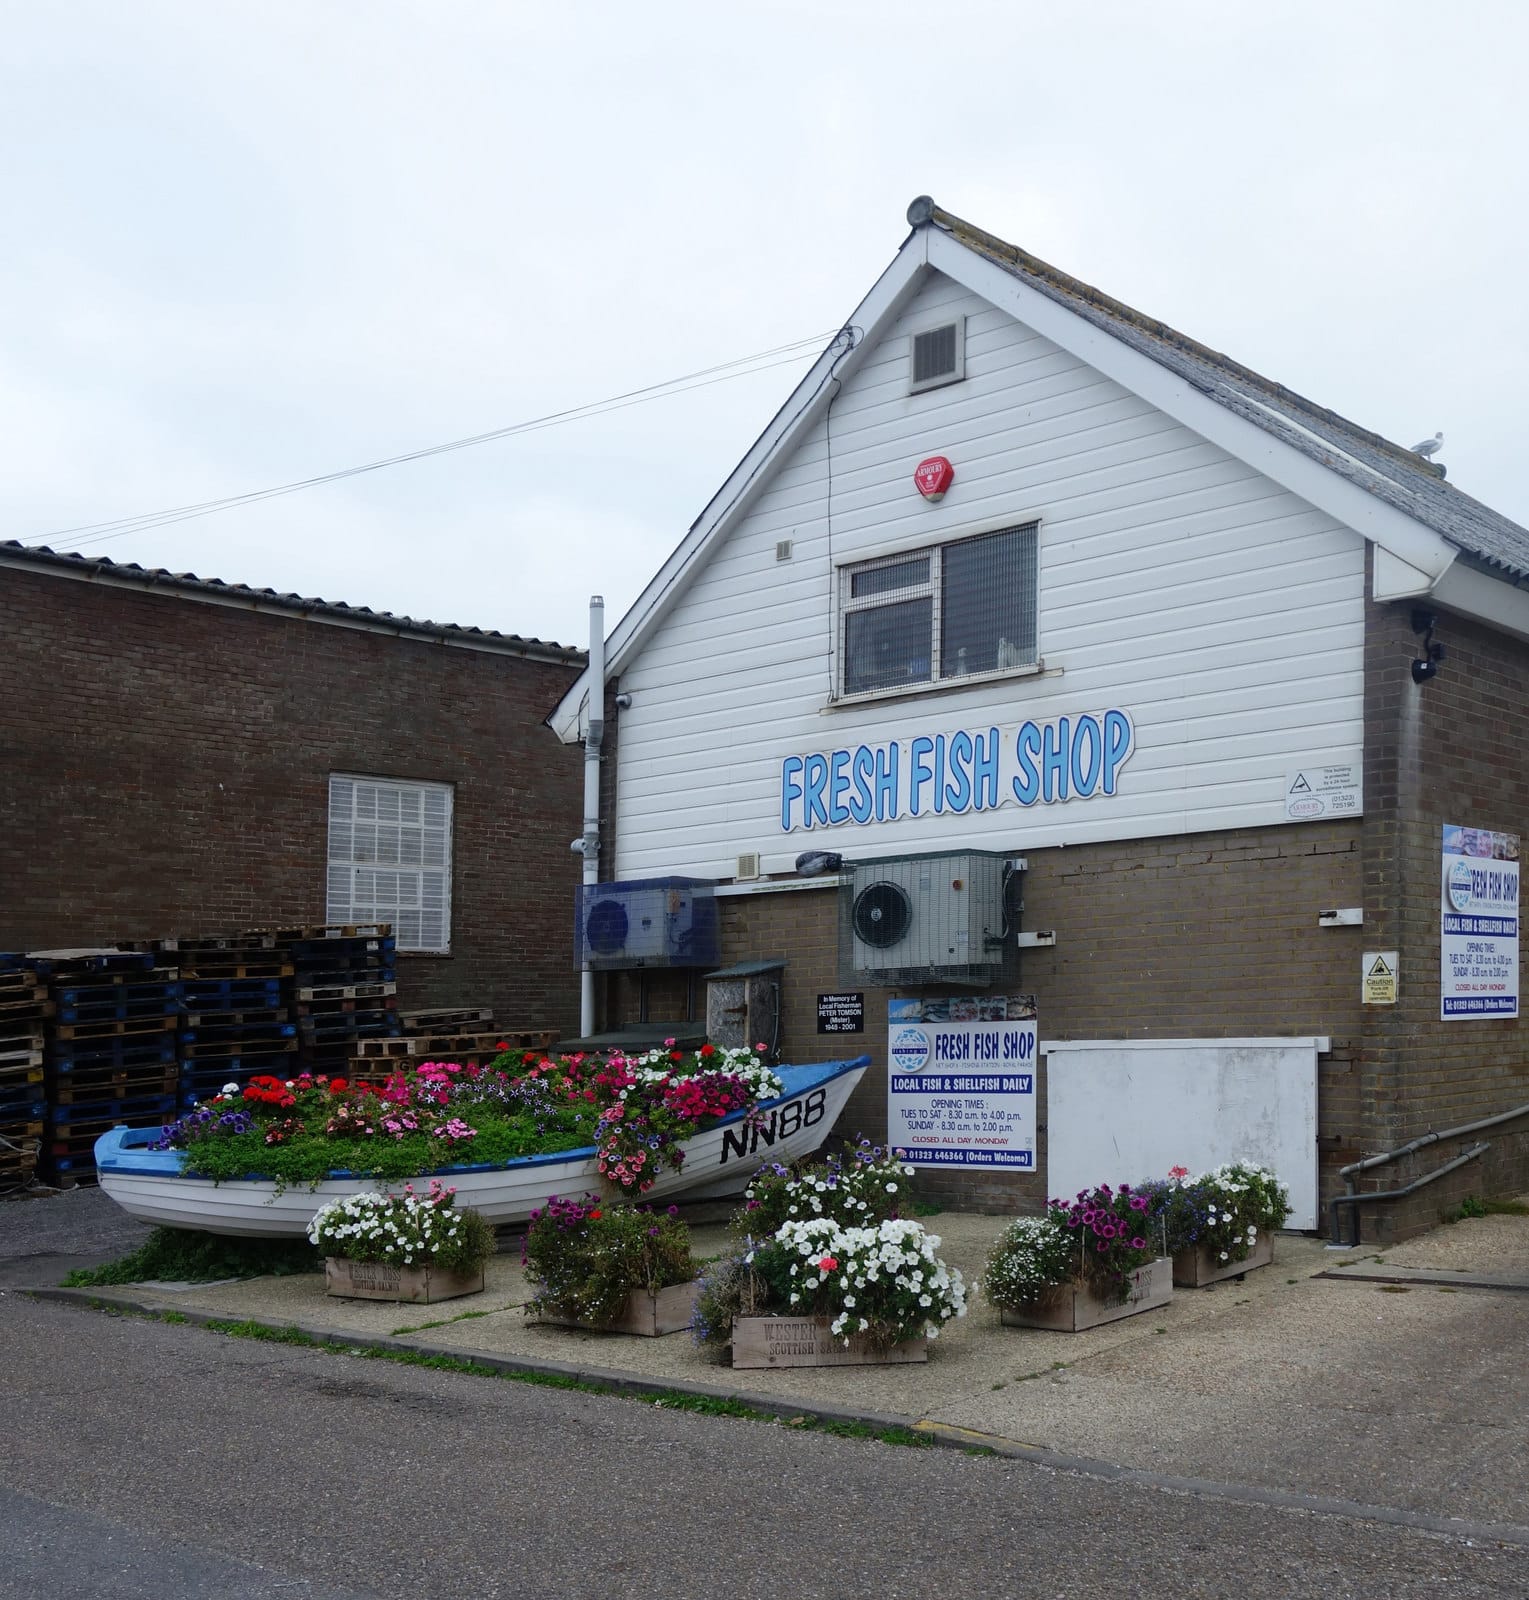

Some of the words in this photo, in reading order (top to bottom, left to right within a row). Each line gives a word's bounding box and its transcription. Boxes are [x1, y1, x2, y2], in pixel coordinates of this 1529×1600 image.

[781, 741, 899, 832] FRESH
[909, 726, 1000, 817] FISH
[1012, 709, 1131, 806] SHOP
[1470, 869, 1487, 899] RESH
[1489, 872, 1502, 900] FISH
[1503, 872, 1517, 902] SHOP
[1445, 917, 1460, 931] LOCAL
[935, 1032, 970, 1060] FRESH
[974, 1031, 999, 1060] FISH
[1003, 1031, 1034, 1060] SHOP
[894, 1077, 920, 1091] LOCAL
[922, 1078, 942, 1091] FISH
[944, 1078, 951, 1090] &
[954, 1078, 1000, 1091] SHELLFISH
[1003, 1077, 1029, 1091] DAILY
[931, 1099, 962, 1109] OPENING
[964, 1099, 984, 1109] TIMES
[901, 1109, 916, 1119] TUES
[919, 1109, 928, 1119] TO
[930, 1110, 942, 1119] SAT
[948, 1110, 962, 1120] 8.30
[965, 1112, 978, 1120] a.m.
[981, 1111, 988, 1120] to
[990, 1110, 1005, 1120] 4.00
[1007, 1113, 1021, 1122] p.m.
[720, 1088, 826, 1164] NN88
[908, 1121, 935, 1130] SUNDAY
[941, 1122, 956, 1130] 8.30
[958, 1123, 971, 1131] a.m.
[974, 1122, 980, 1131] to
[982, 1122, 997, 1131] 2.00
[999, 1124, 1013, 1134] p.m.
[974, 1137, 1009, 1145] MONDAY
[909, 1151, 932, 1159] 01323
[935, 1152, 963, 1160] 646366
[966, 1153, 992, 1162] (Orders
[994, 1153, 1028, 1164] Welcome)
[763, 1323, 817, 1341] WESTER
[769, 1342, 814, 1355] SCOTTISH
